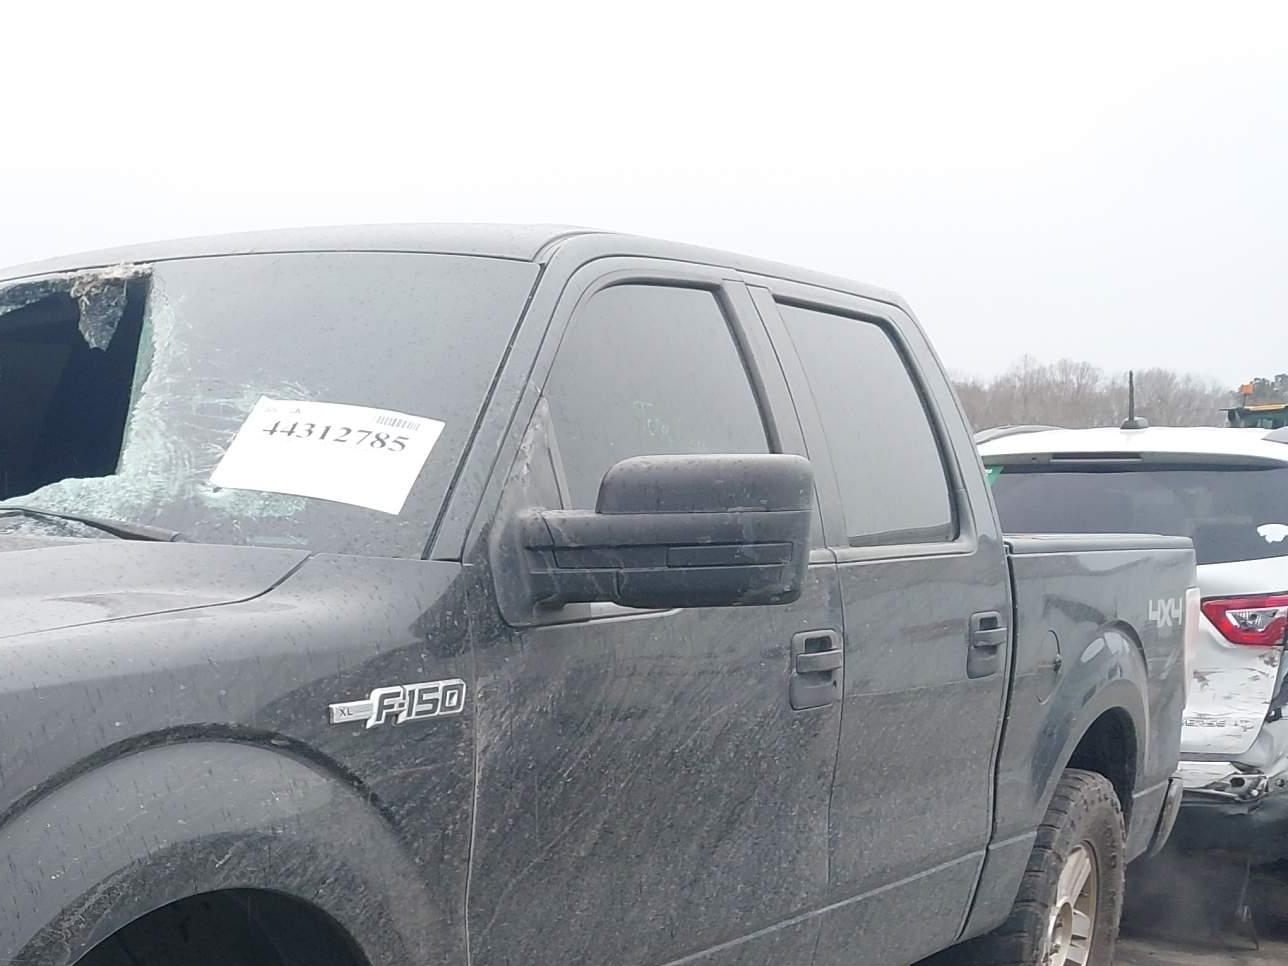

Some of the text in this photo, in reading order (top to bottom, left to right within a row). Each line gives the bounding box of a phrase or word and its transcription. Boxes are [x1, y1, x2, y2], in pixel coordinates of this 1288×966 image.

[262, 419, 410, 451] 44312785
[339, 679, 466, 728] XL F-150
